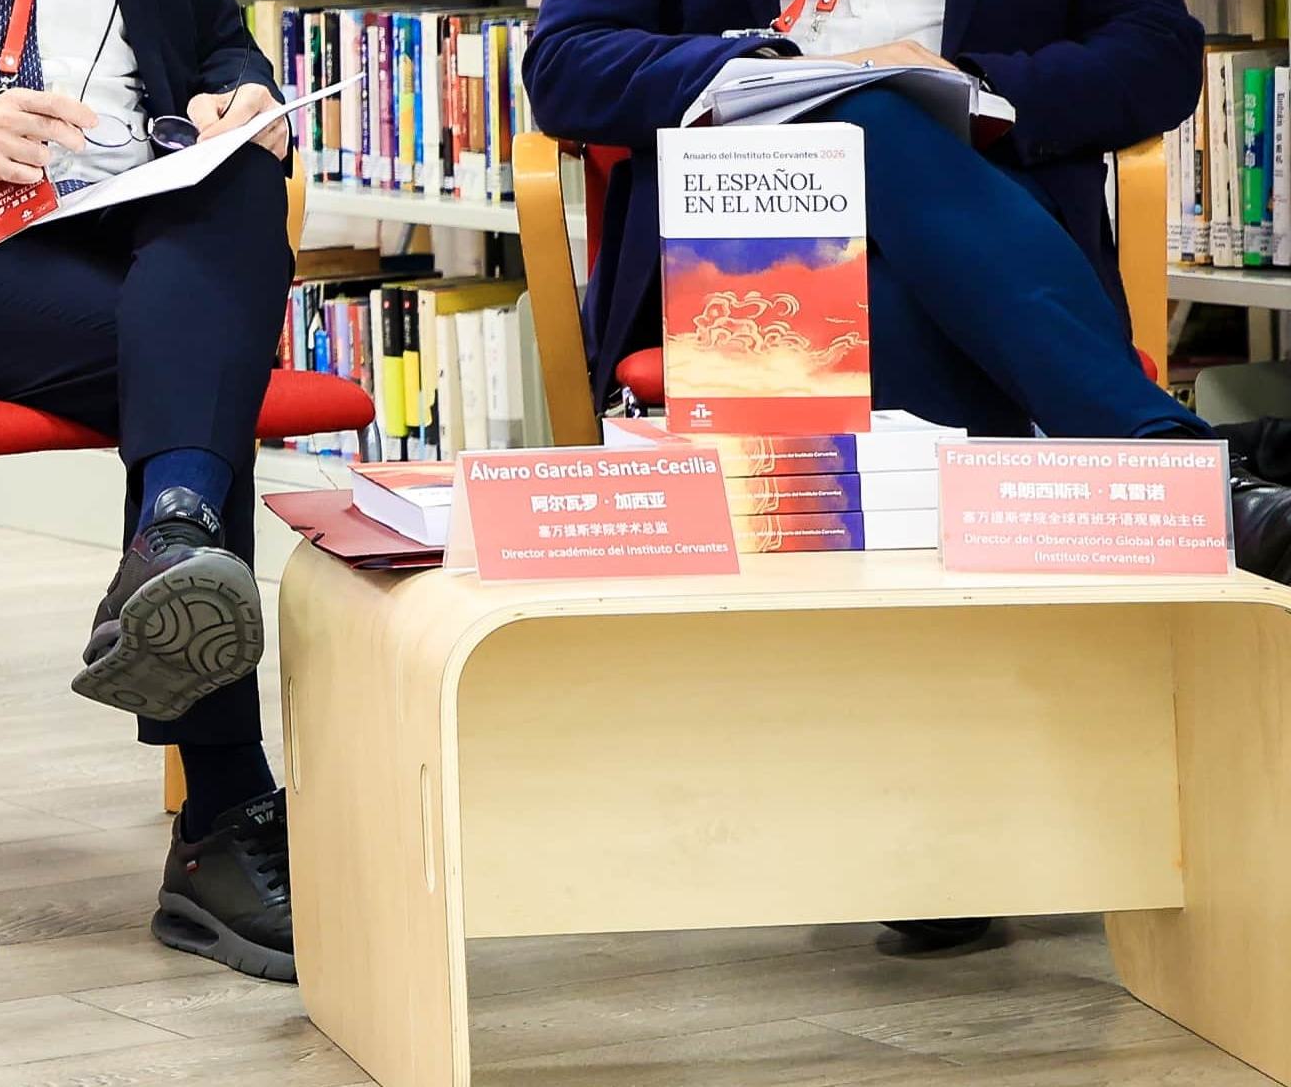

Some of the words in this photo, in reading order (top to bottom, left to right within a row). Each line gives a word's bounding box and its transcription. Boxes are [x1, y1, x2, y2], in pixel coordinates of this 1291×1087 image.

[682, 151, 717, 161] Anuario
[718, 151, 732, 160] del
[734, 150, 771, 160] Instituto
[772, 150, 819, 160] Cervantes
[820, 149, 845, 159] 2026
[684, 174, 715, 192] EL
[717, 168, 822, 192] ESPAÑOL
[685, 196, 714, 213] EN
[722, 195, 749, 213] EL
[755, 194, 848, 213] MUNDO
[946, 450, 1031, 468] Francisco
[1037, 451, 1112, 468] Moreno
[1118, 450, 1216, 468] Fernández
[469, 461, 531, 481] Álvaro
[534, 459, 594, 480] García
[598, 456, 717, 477] Santa-Cecilia
[501, 548, 546, 560] Director
[547, 545, 605, 559] académico
[607, 544, 625, 557] del
[626, 543, 673, 556] Instituto
[674, 542, 728, 555] Cervantes
[964, 534, 1011, 545] Director
[1015, 535, 1033, 545] del
[1036, 535, 1113, 546] Observatorio
[1115, 535, 1153, 547] Global
[1157, 536, 1175, 547] del
[1178, 536, 1226, 550] Español
[1035, 551, 1090, 565] (Instituto
[1091, 552, 1155, 566] Cervantes)
